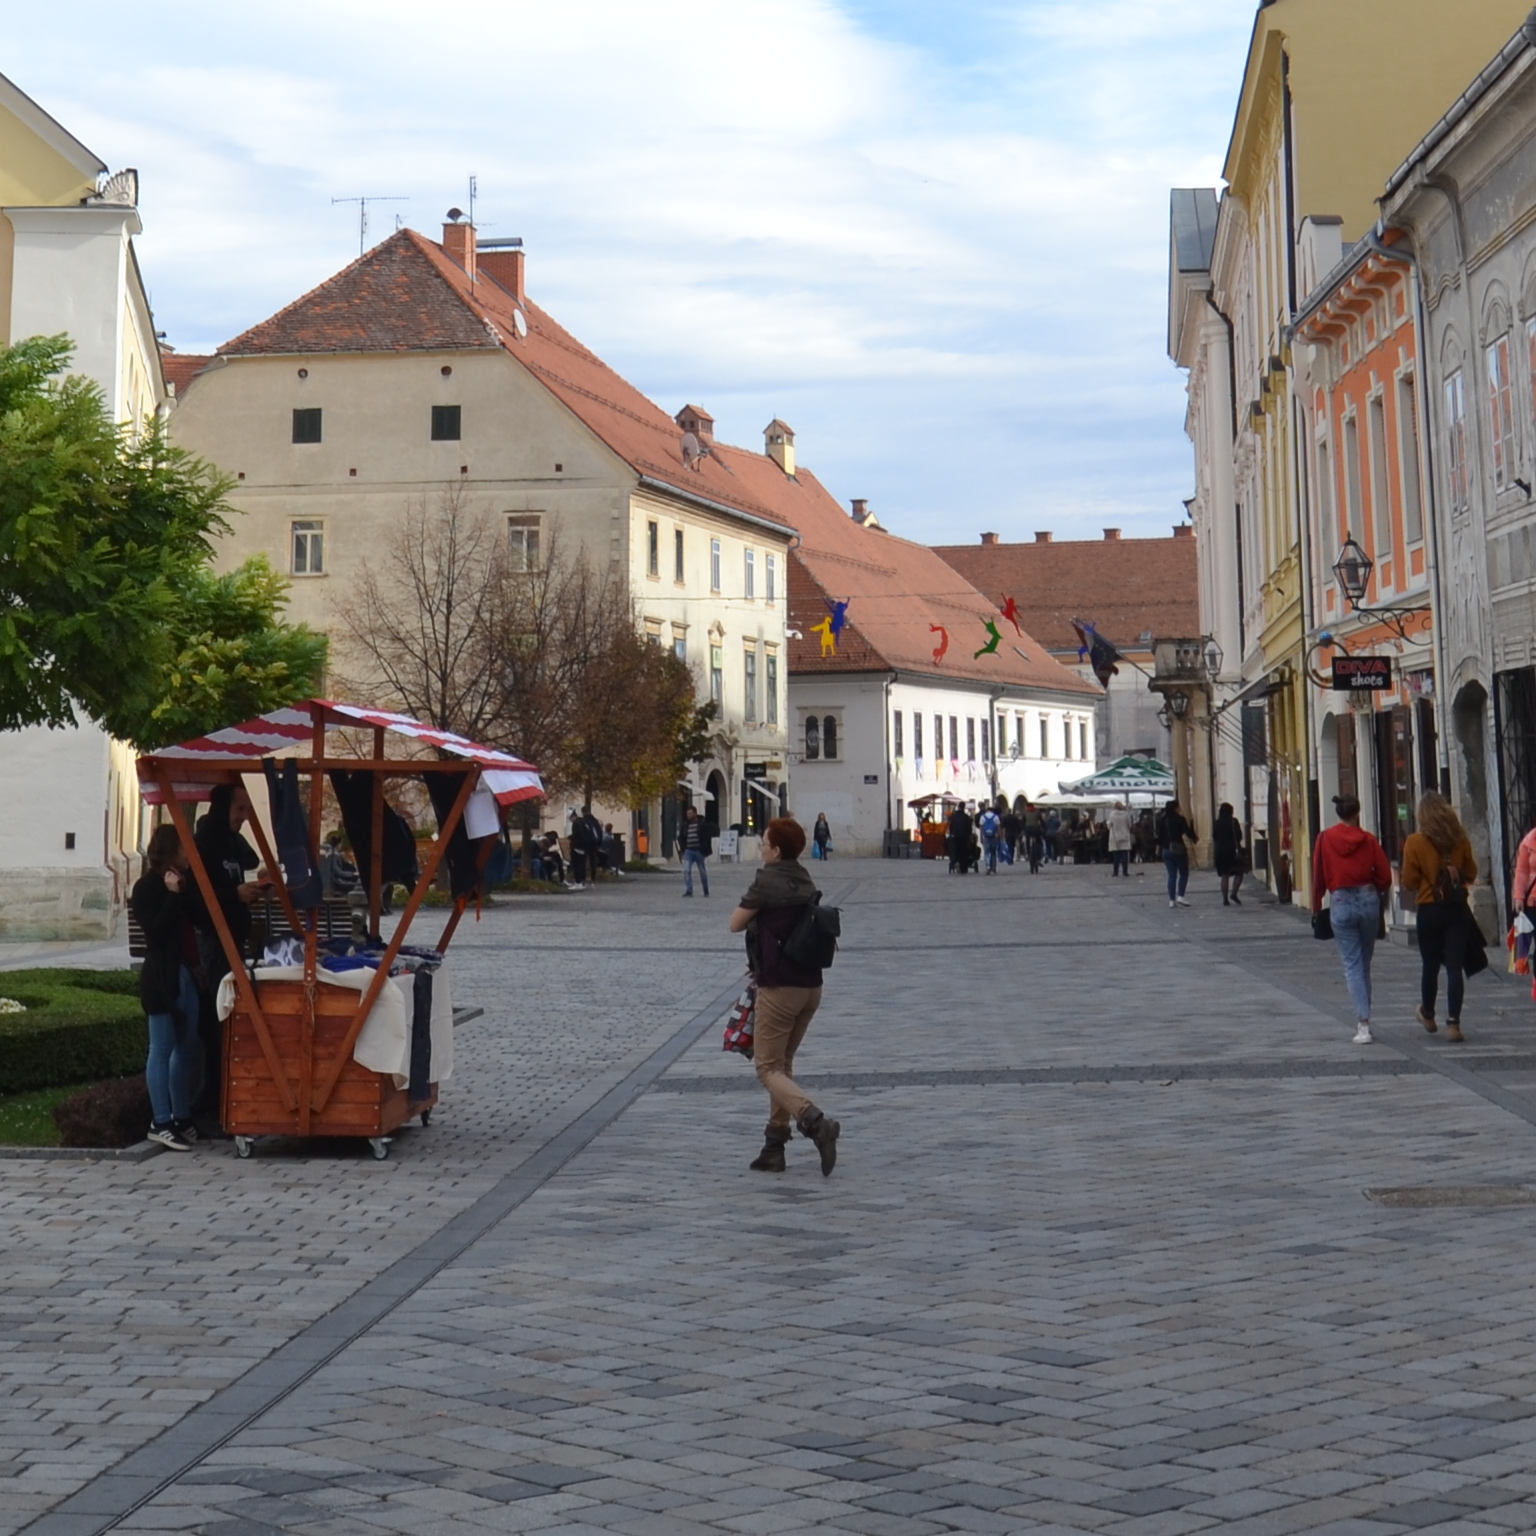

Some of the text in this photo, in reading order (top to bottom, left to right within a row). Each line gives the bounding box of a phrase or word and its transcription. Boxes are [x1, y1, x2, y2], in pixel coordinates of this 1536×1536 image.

[1335, 660, 1388, 674] DIVA
[1351, 671, 1384, 686] shoes
[1080, 778, 1174, 789] Heineke
